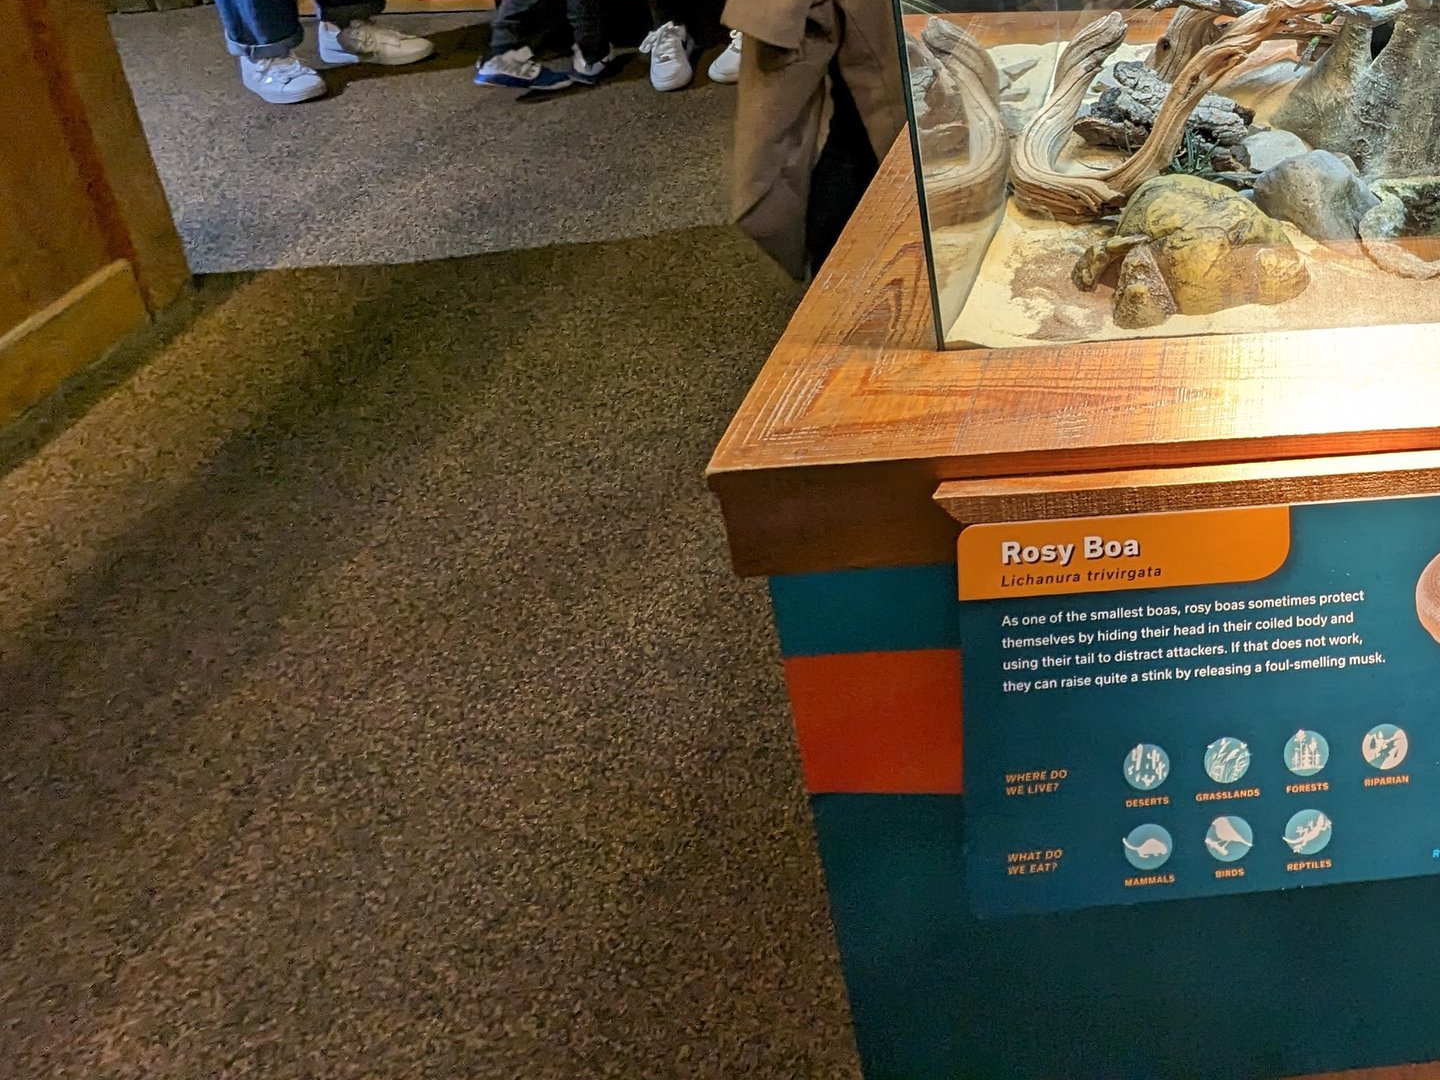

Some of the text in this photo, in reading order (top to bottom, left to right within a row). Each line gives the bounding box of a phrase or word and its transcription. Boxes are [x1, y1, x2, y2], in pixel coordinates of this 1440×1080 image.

[1001, 535, 1140, 567] Rosy Boa
[1001, 566, 1162, 588] Lichanura trivirgata
[1001, 590, 1365, 627] As one of the smallest boas, rosy boas sometimes protect
[1001, 611, 1354, 649] themselves by hiding their head in their coiled body and
[1003, 632, 1363, 671] using their tail to distract attackers. If that does not work,
[1003, 651, 1386, 694] they can raise quite a stink by releasing a foul-smelling musk.
[1005, 769, 1068, 783] WHERE DO
[1364, 775, 1409, 787] RIPARIAN
[1006, 783, 1059, 796] WE LIVE?
[1286, 782, 1329, 794] FORESTS
[1195, 788, 1260, 802] GRASSLANDS
[1125, 796, 1169, 808] DESERTS
[1007, 849, 1063, 862] WHAT DO
[1007, 863, 1058, 875] WE EAT?
[1287, 860, 1332, 872] REPTILES
[1215, 868, 1245, 879] BIRDS
[1124, 874, 1176, 887] MAMMALS
